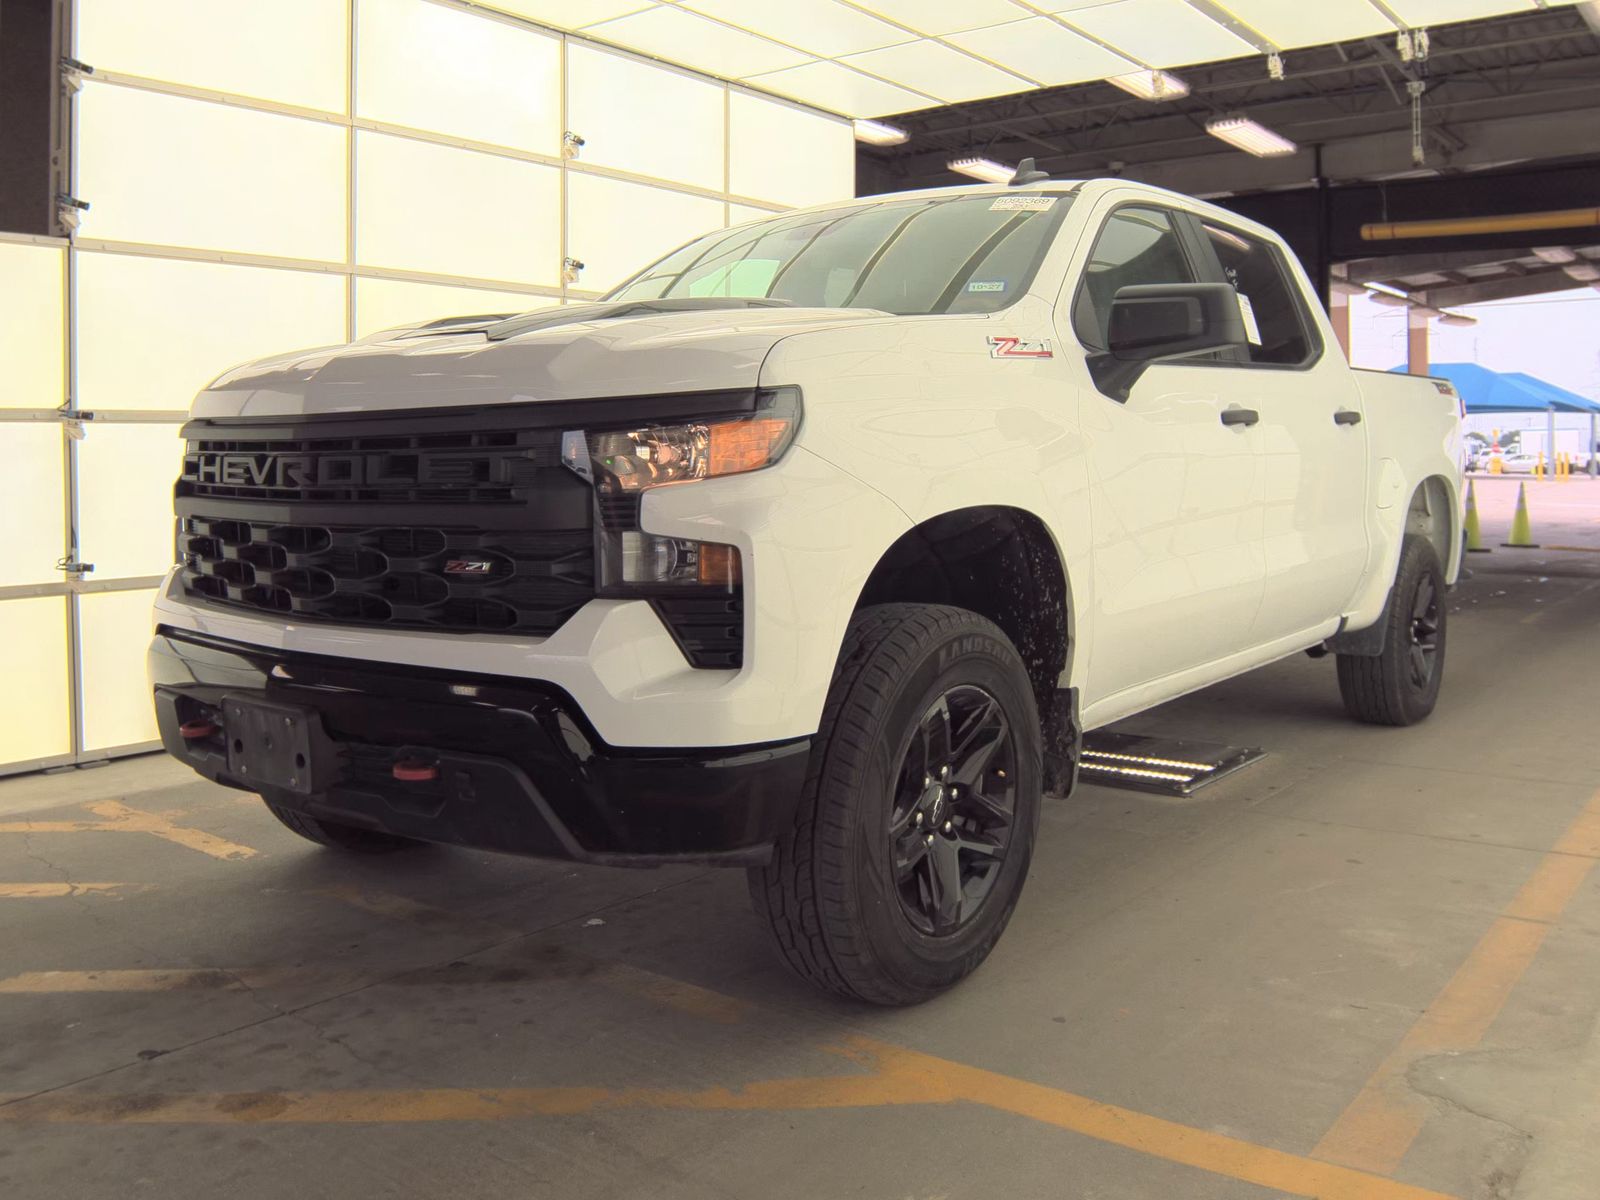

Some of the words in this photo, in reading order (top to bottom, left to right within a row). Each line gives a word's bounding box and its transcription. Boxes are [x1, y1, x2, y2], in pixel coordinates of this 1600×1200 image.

[986, 336, 1053, 358] Z71
[181, 450, 527, 486] CHEVROLET
[444, 560, 491, 573] Z71
